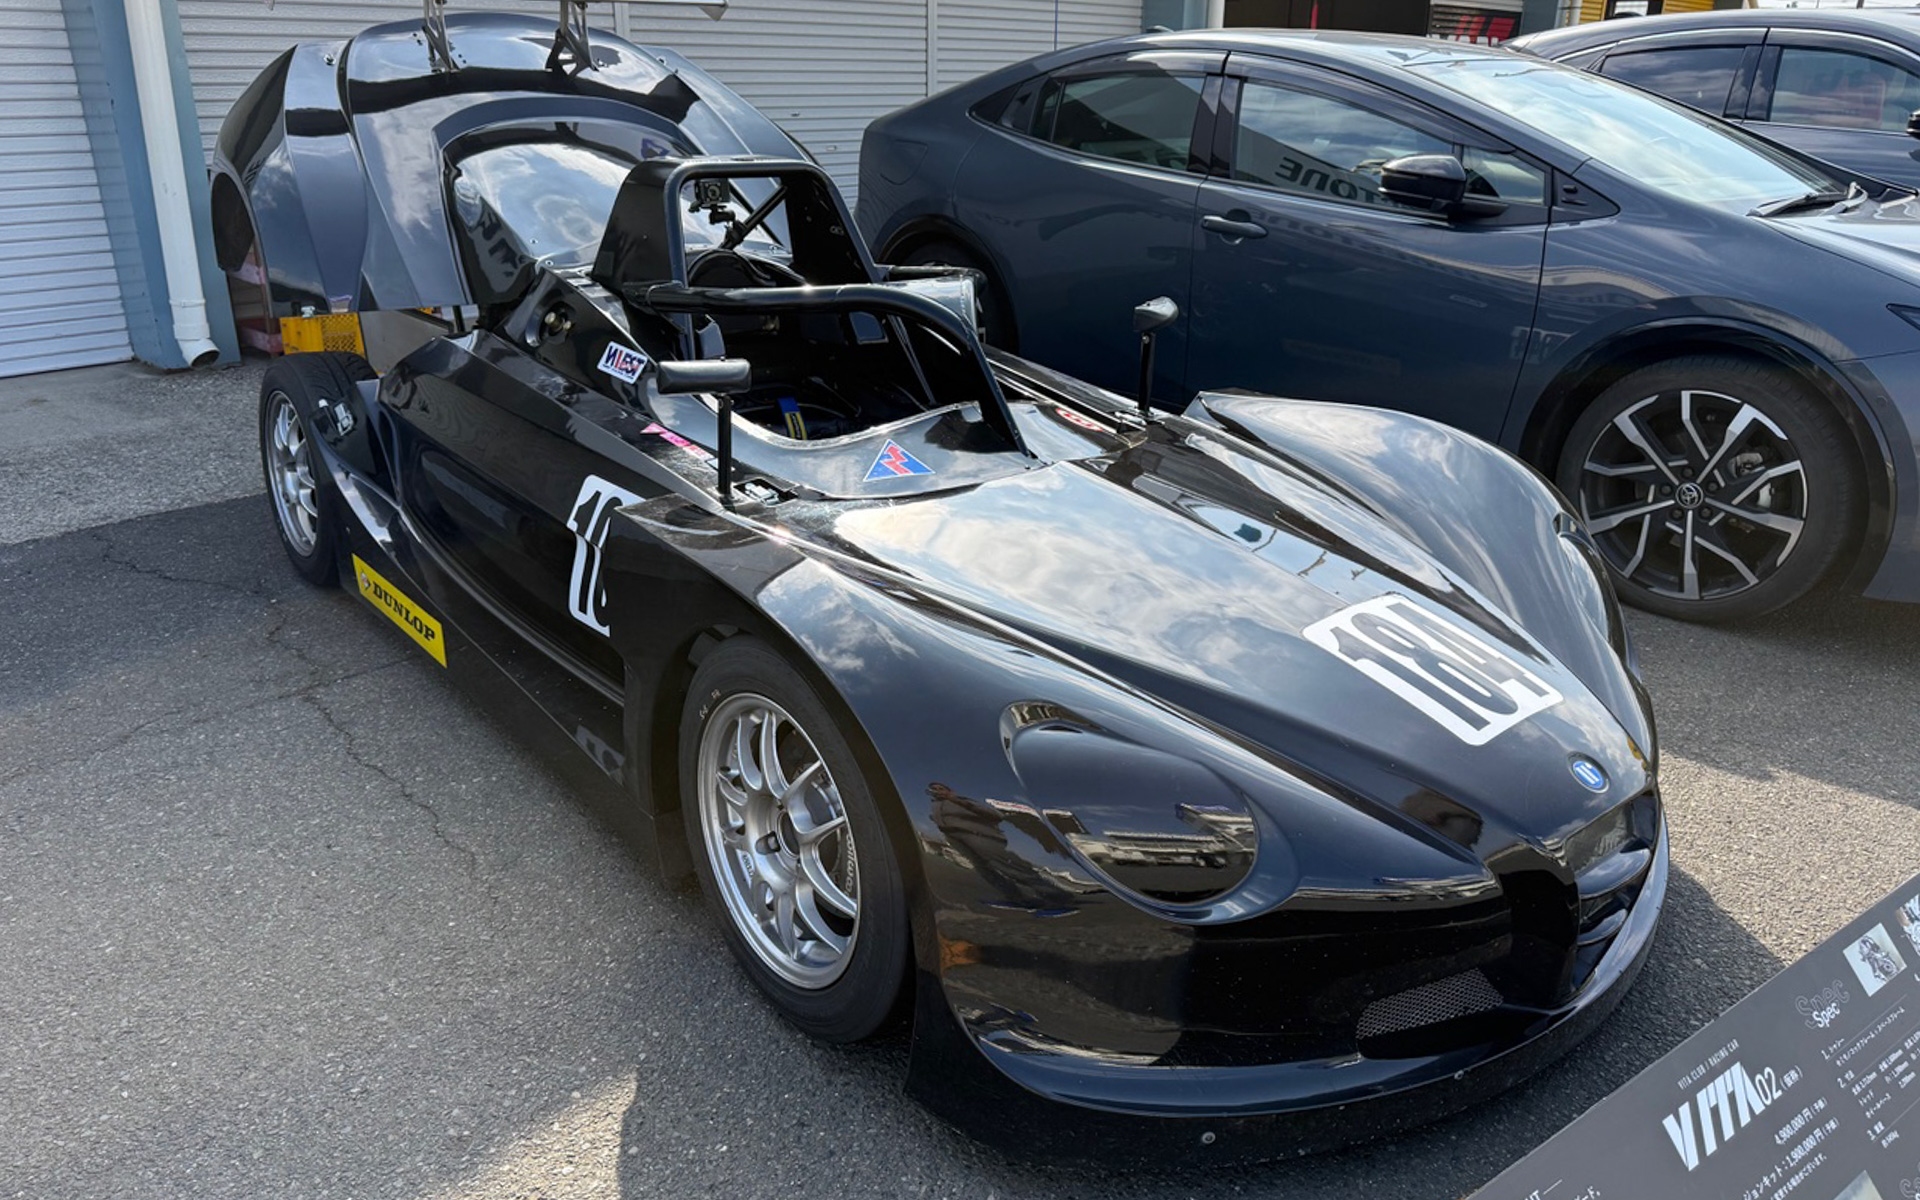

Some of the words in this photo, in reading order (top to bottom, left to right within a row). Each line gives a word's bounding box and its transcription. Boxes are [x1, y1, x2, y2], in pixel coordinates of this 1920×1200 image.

[373, 581, 435, 641] DUNLOP
[1329, 602, 1550, 731] 184
[1812, 1002, 1841, 1028] Spec
[1677, 1075, 1692, 1090] VITA
[1690, 1064, 1707, 1080] CLUB
[1708, 1046, 1729, 1067] RACING
[1727, 1038, 1740, 1053] CAR
[1662, 1061, 1766, 1172] VITA
[1755, 1066, 1783, 1106] 02
